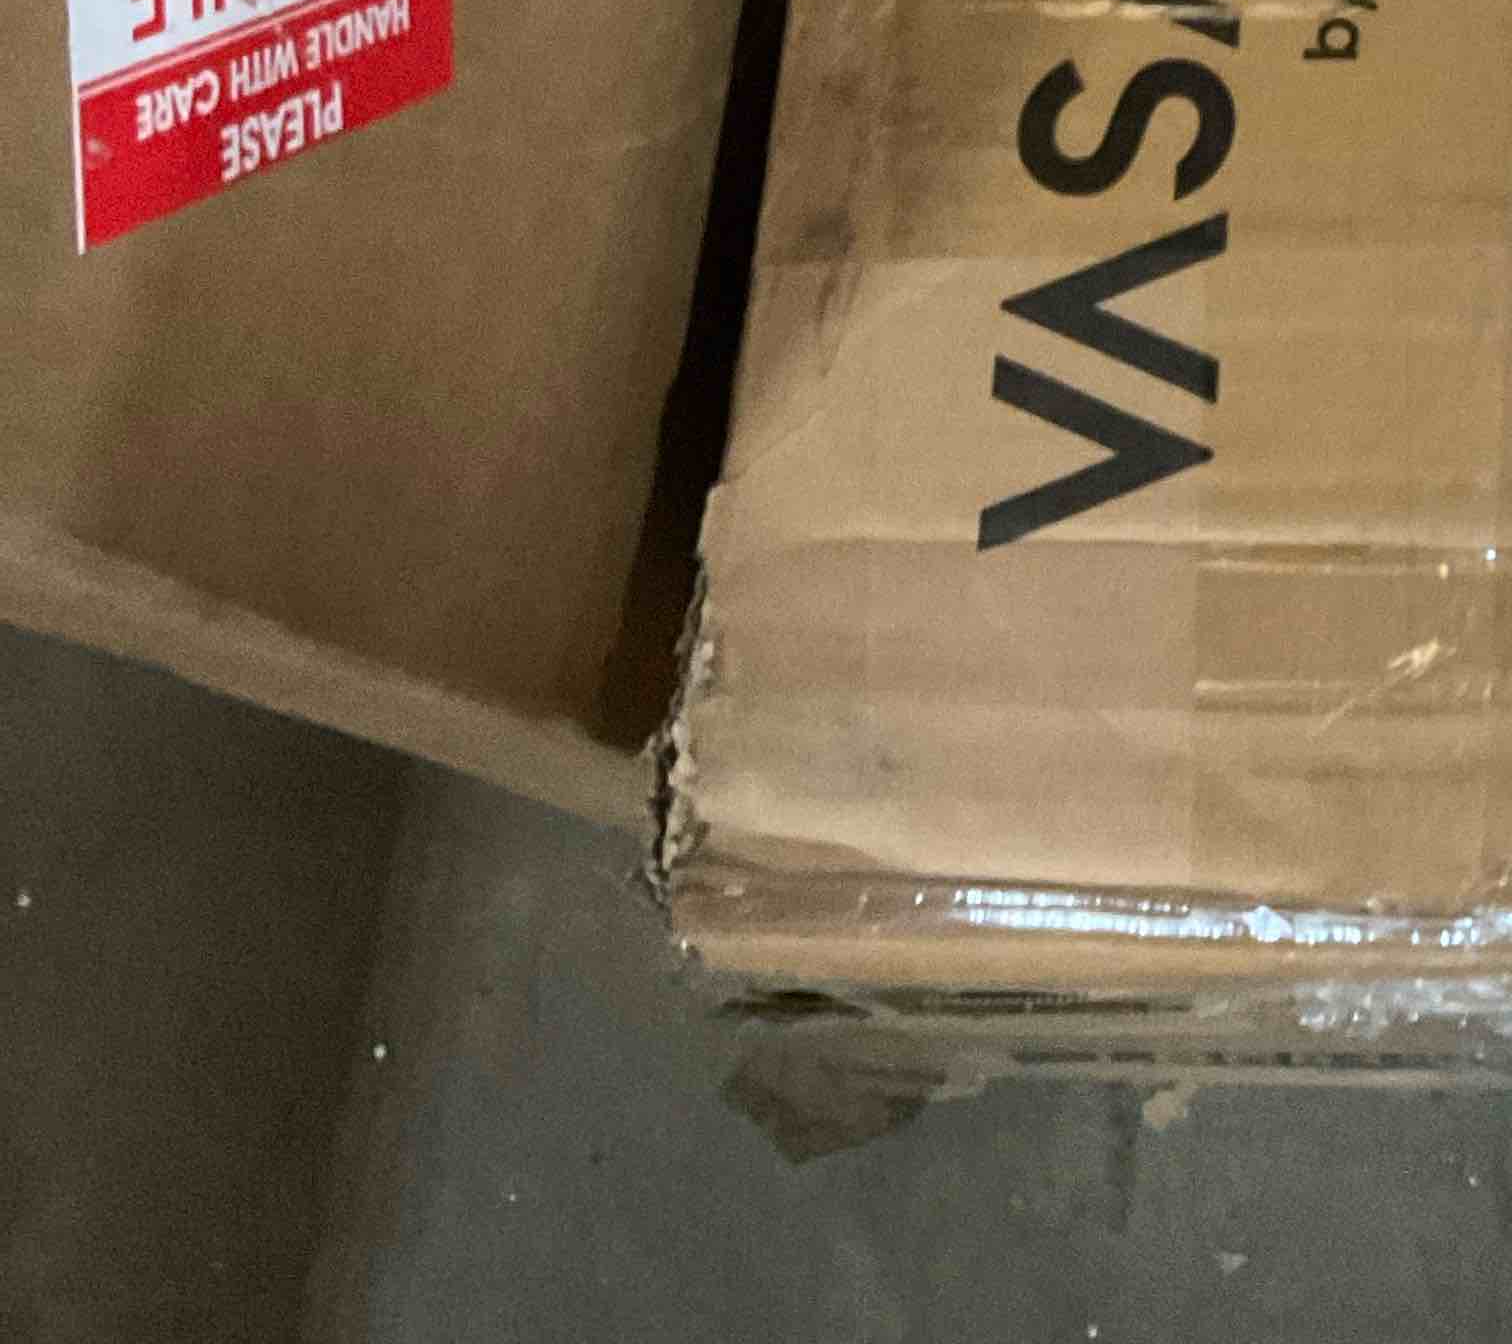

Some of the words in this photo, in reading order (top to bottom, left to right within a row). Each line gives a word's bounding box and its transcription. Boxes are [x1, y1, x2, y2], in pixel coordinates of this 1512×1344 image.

[230, 29, 301, 100] WITH
[135, 71, 220, 143] CARE
[221, 81, 344, 183] PLEASE
